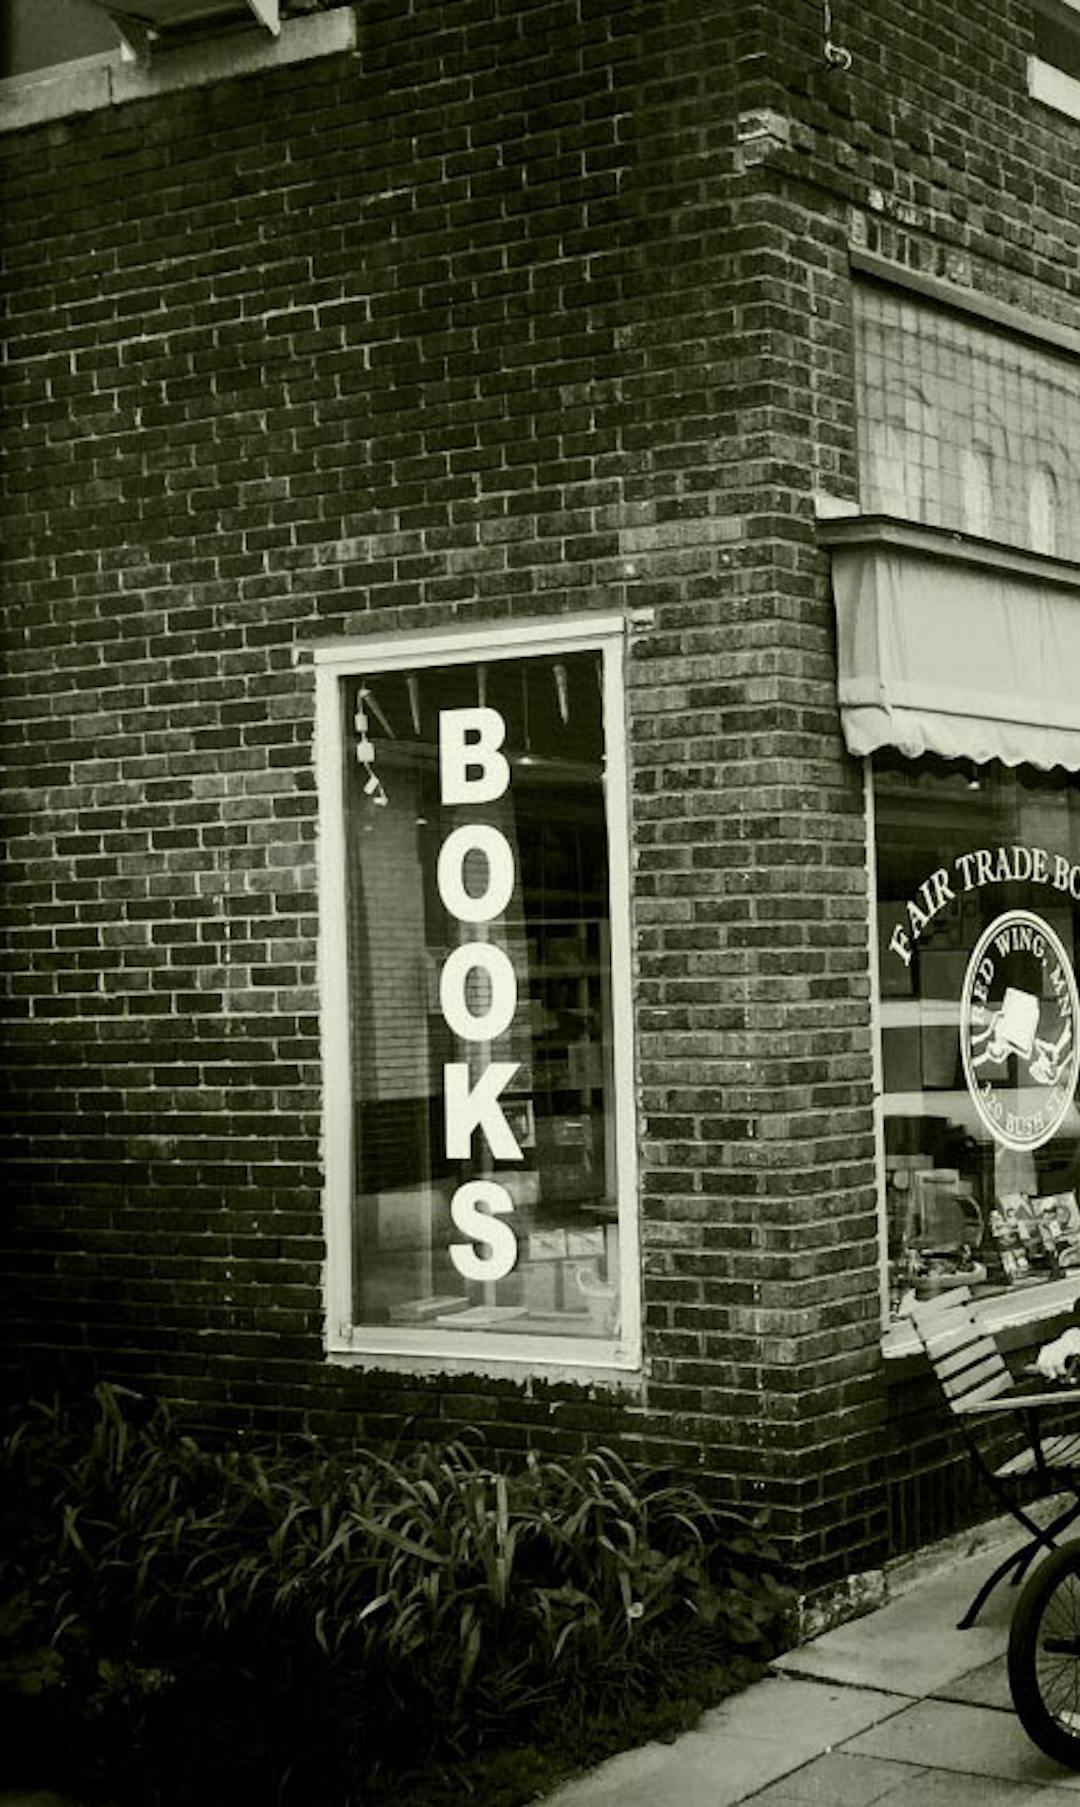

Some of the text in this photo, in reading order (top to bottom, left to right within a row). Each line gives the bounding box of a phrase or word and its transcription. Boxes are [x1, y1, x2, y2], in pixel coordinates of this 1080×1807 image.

[437, 707, 524, 1282] BOOKS
[889, 868, 956, 967] FAIR
[955, 845, 1050, 891] TRADE
